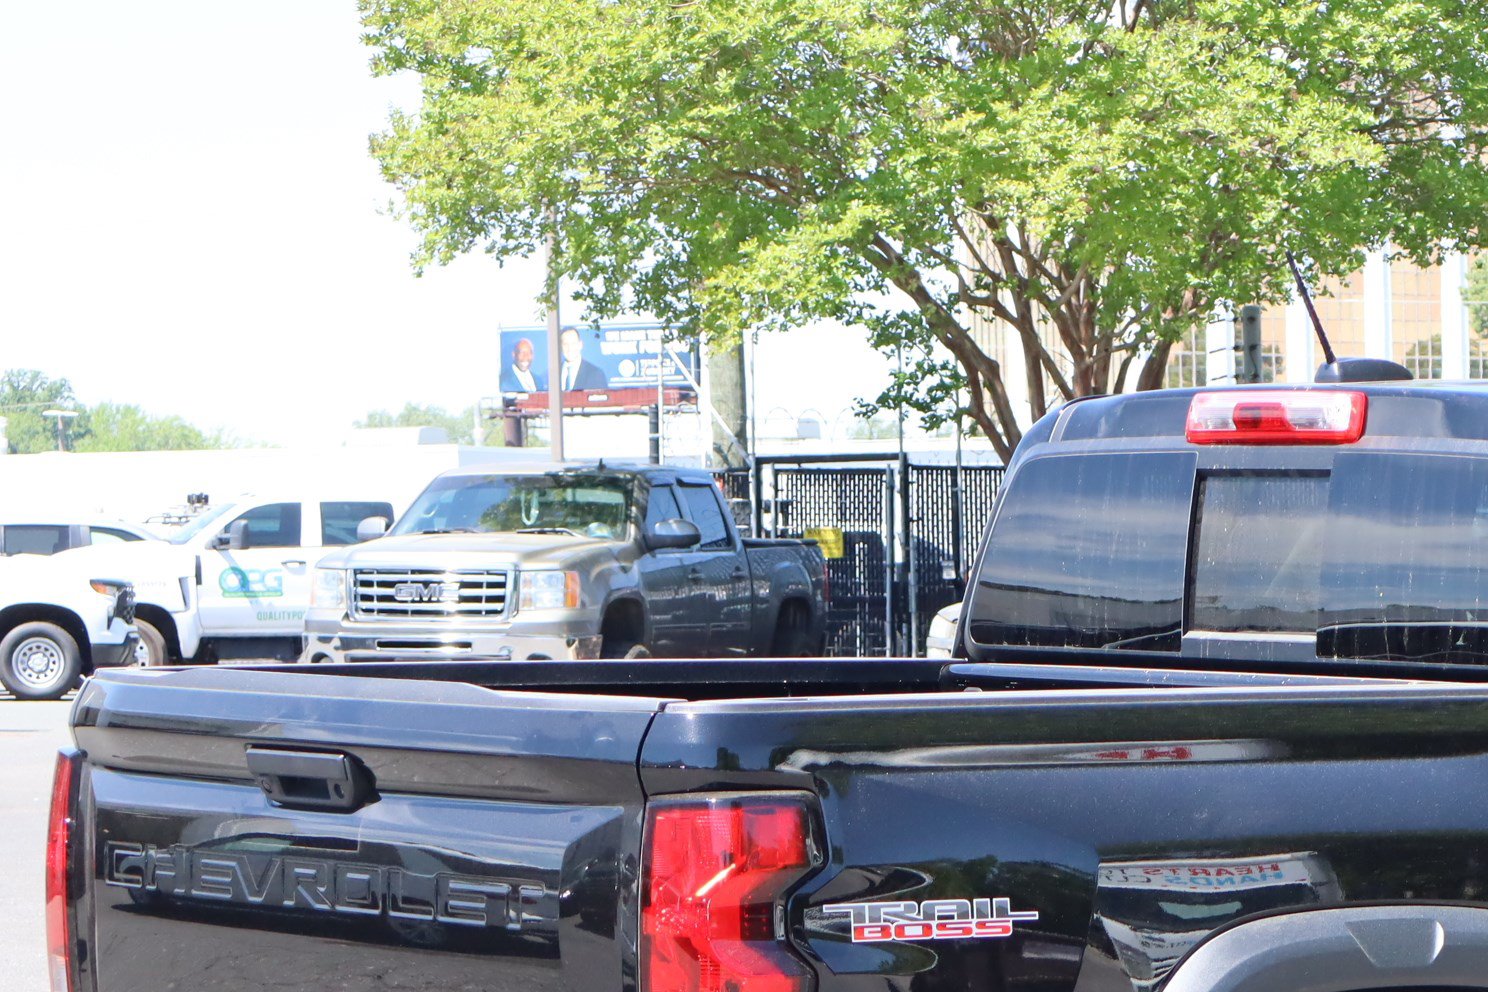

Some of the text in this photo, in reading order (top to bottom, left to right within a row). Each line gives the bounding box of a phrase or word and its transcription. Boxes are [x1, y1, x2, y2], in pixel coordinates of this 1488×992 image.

[394, 583, 460, 601] GMC
[256, 610, 306, 621] QUALITYPO
[104, 840, 546, 930] CHEVROLET
[822, 897, 1039, 925] TRAIL
[851, 919, 1013, 943] BOSS
